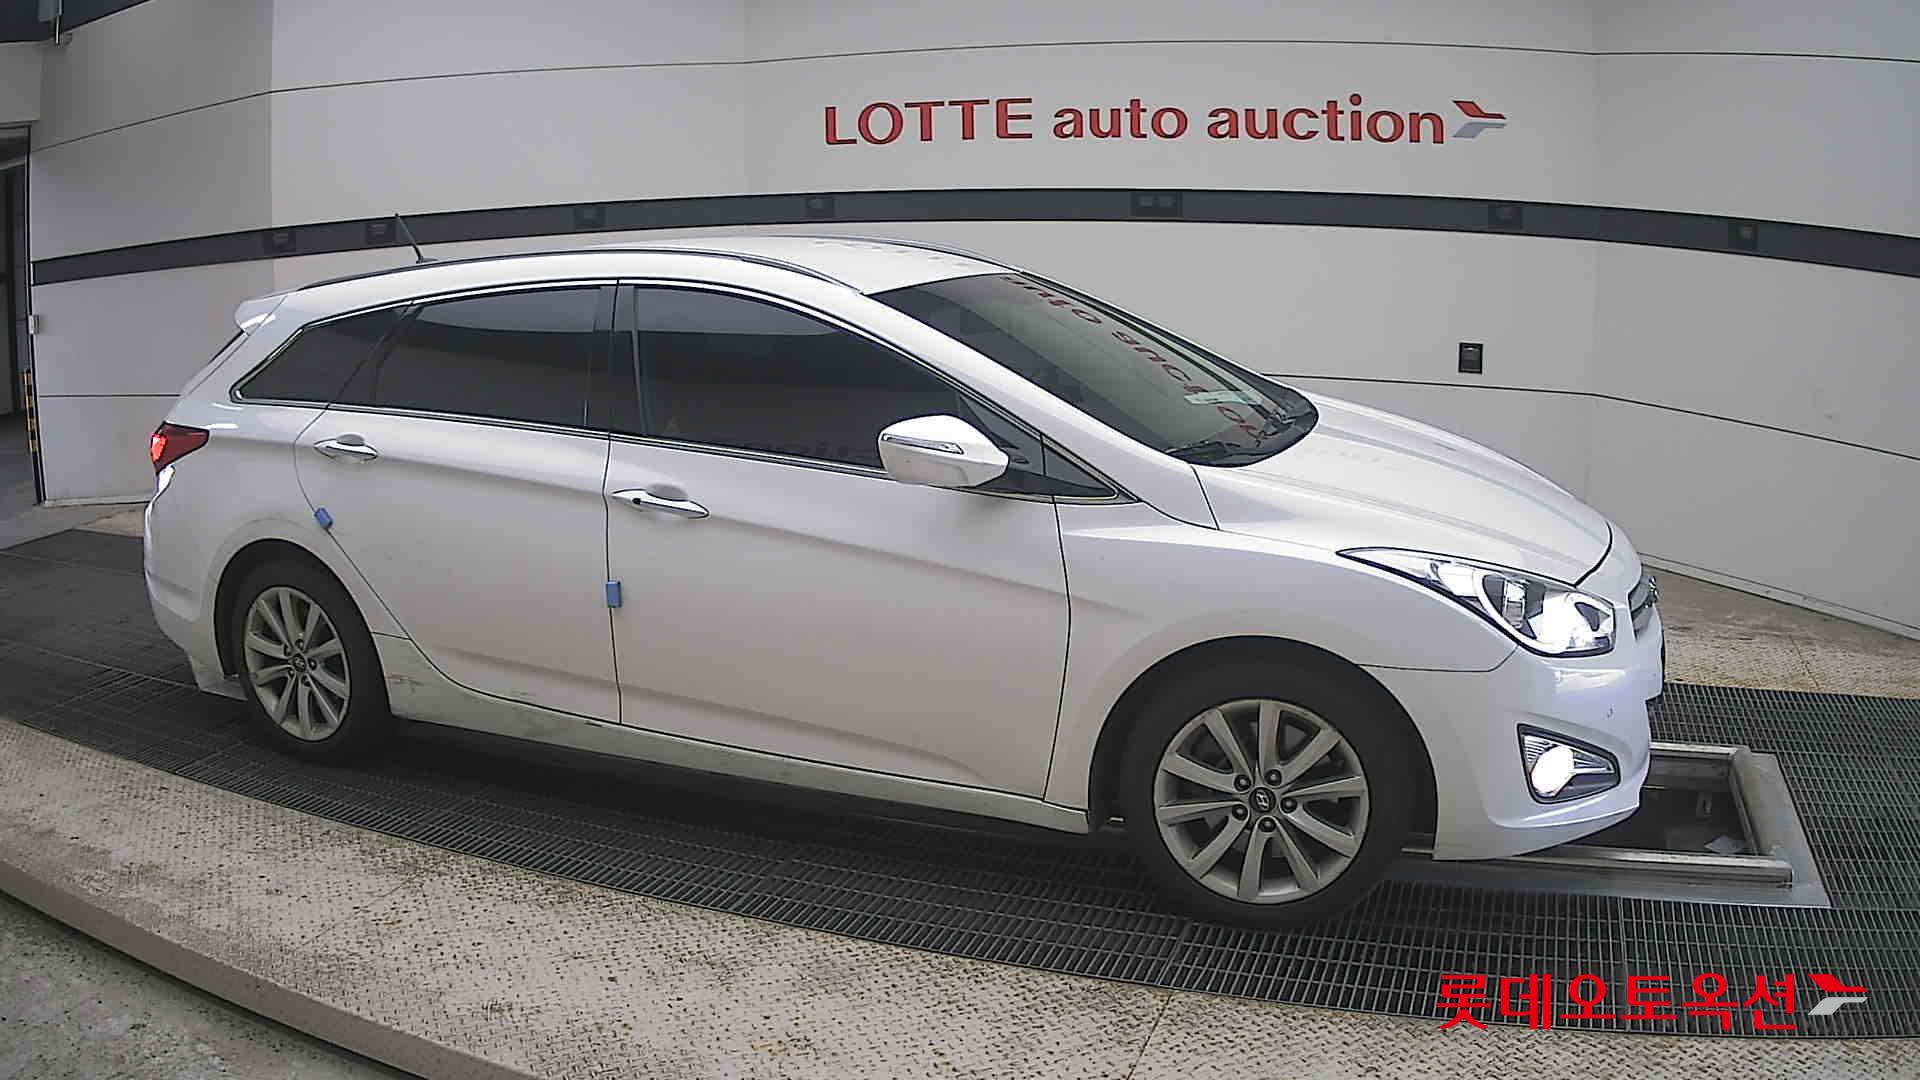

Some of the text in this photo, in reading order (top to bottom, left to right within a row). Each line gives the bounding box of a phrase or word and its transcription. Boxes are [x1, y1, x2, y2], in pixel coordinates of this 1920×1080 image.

[824, 93, 1445, 145] LOTTE auto auction
